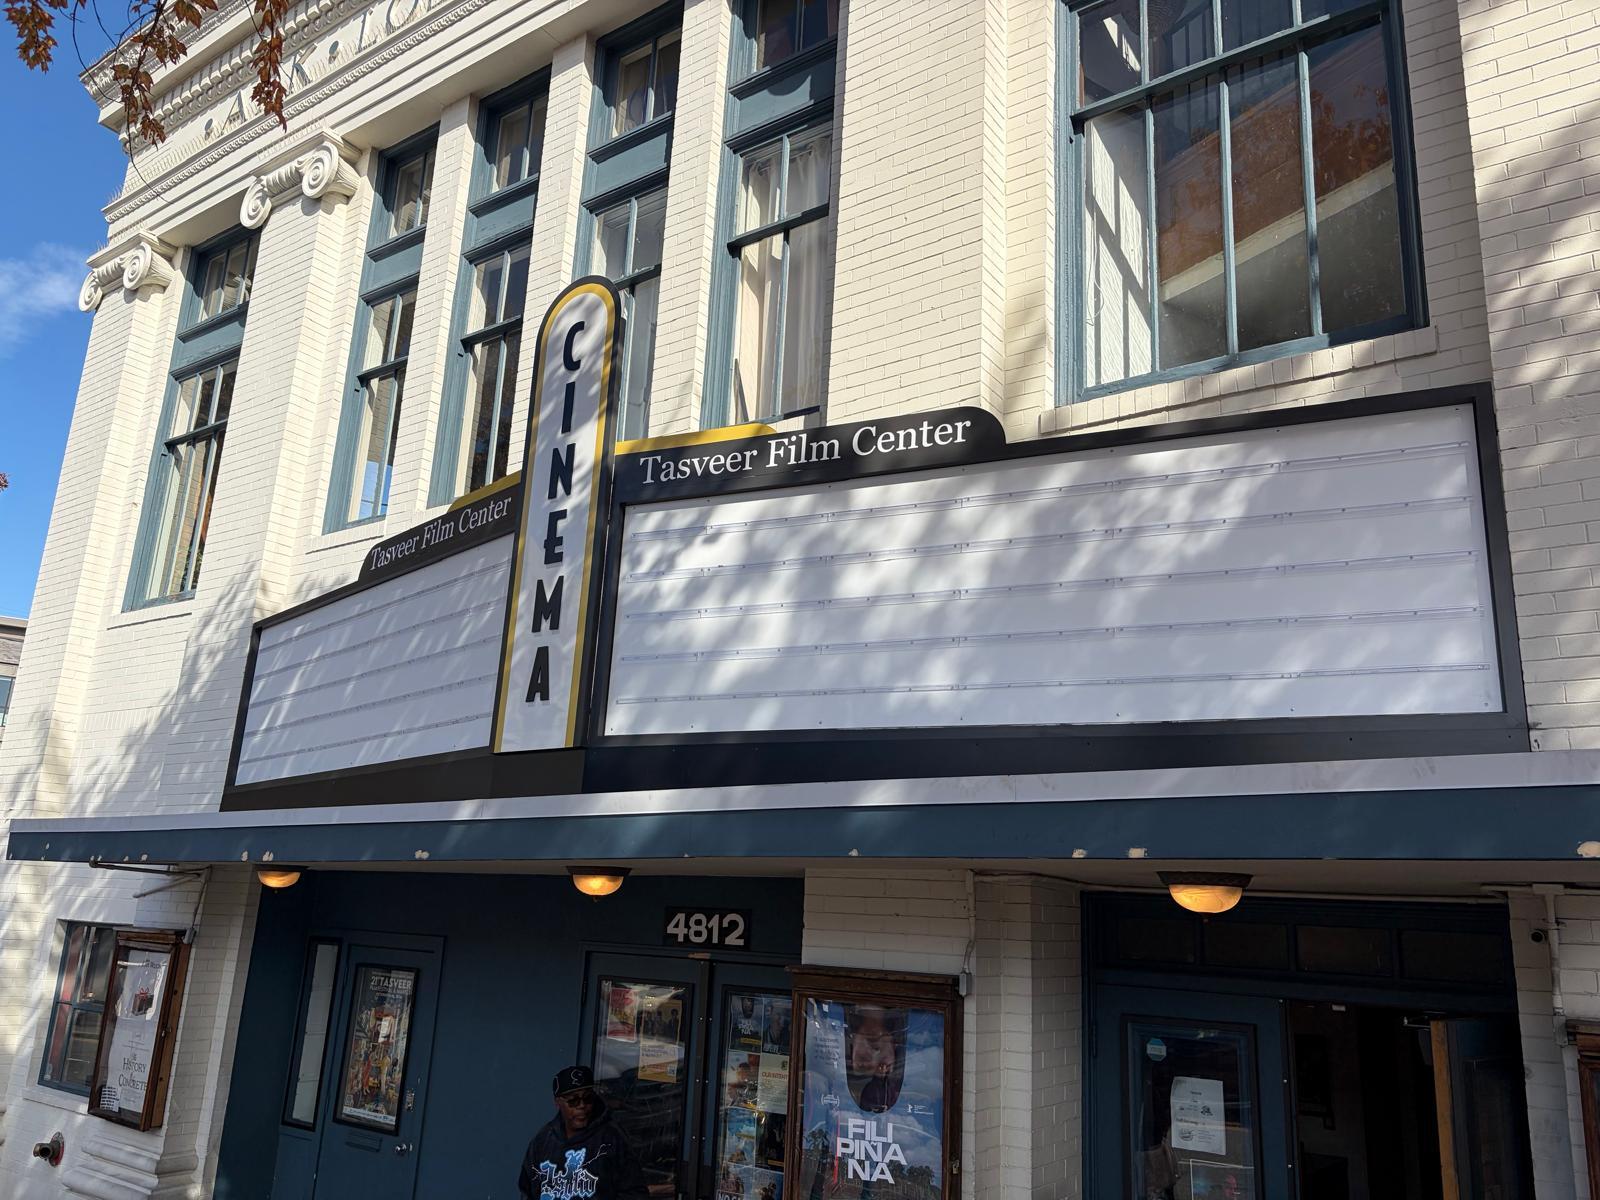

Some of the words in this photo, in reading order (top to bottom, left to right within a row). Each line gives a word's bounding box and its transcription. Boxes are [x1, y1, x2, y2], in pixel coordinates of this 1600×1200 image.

[639, 447, 757, 484] Tasveer
[765, 433, 841, 468] Film
[852, 420, 971, 457] Center
[526, 320, 585, 702] CINEMA
[370, 535, 420, 570] Tasveer
[421, 519, 455, 549] Film
[458, 497, 511, 533] Center
[667, 912, 744, 945] 4812
[380, 977, 412, 990] TASVEER
[848, 1118, 893, 1143] FILI
[837, 1137, 908, 1166] PIÑA
[848, 1158, 895, 1184] NA
